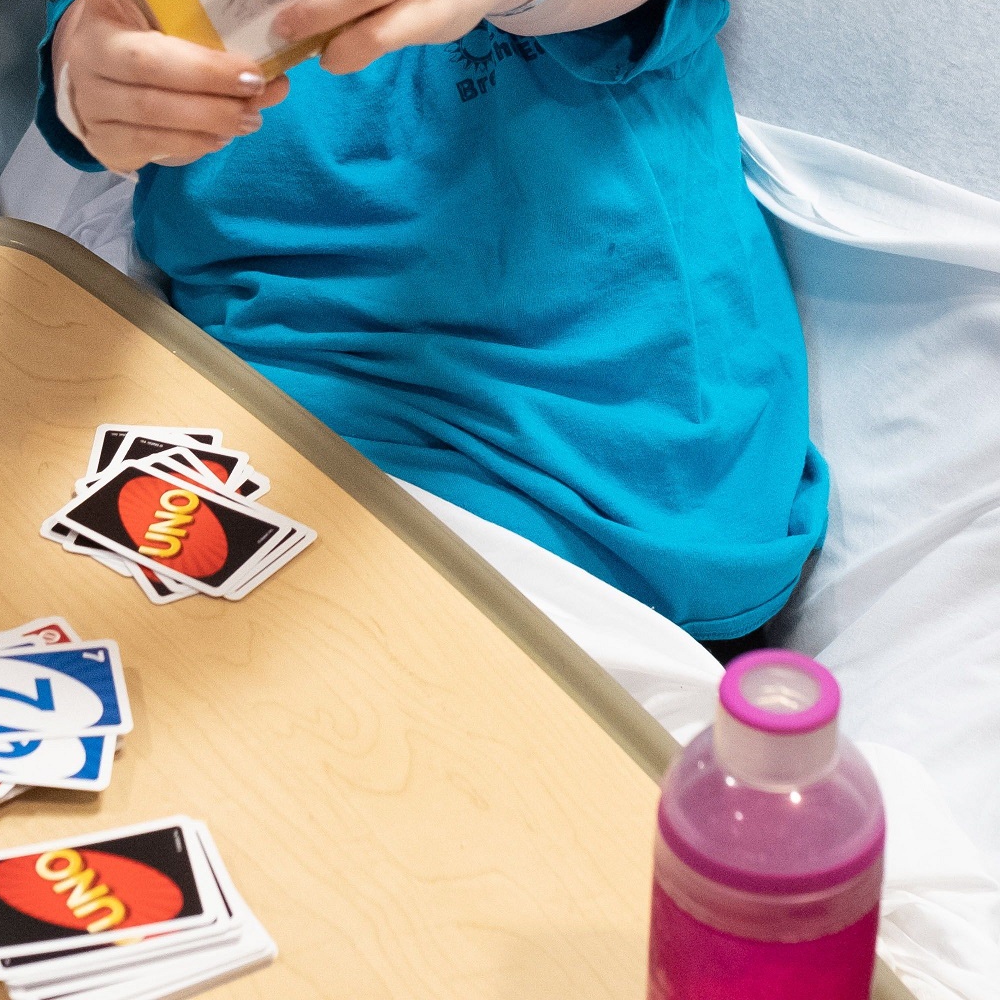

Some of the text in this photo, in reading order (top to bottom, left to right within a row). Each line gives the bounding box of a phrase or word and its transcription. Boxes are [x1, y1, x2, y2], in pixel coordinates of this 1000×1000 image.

[138, 489, 200, 559] UNO
[82, 650, 105, 663] 7
[35, 848, 127, 934] UNO
